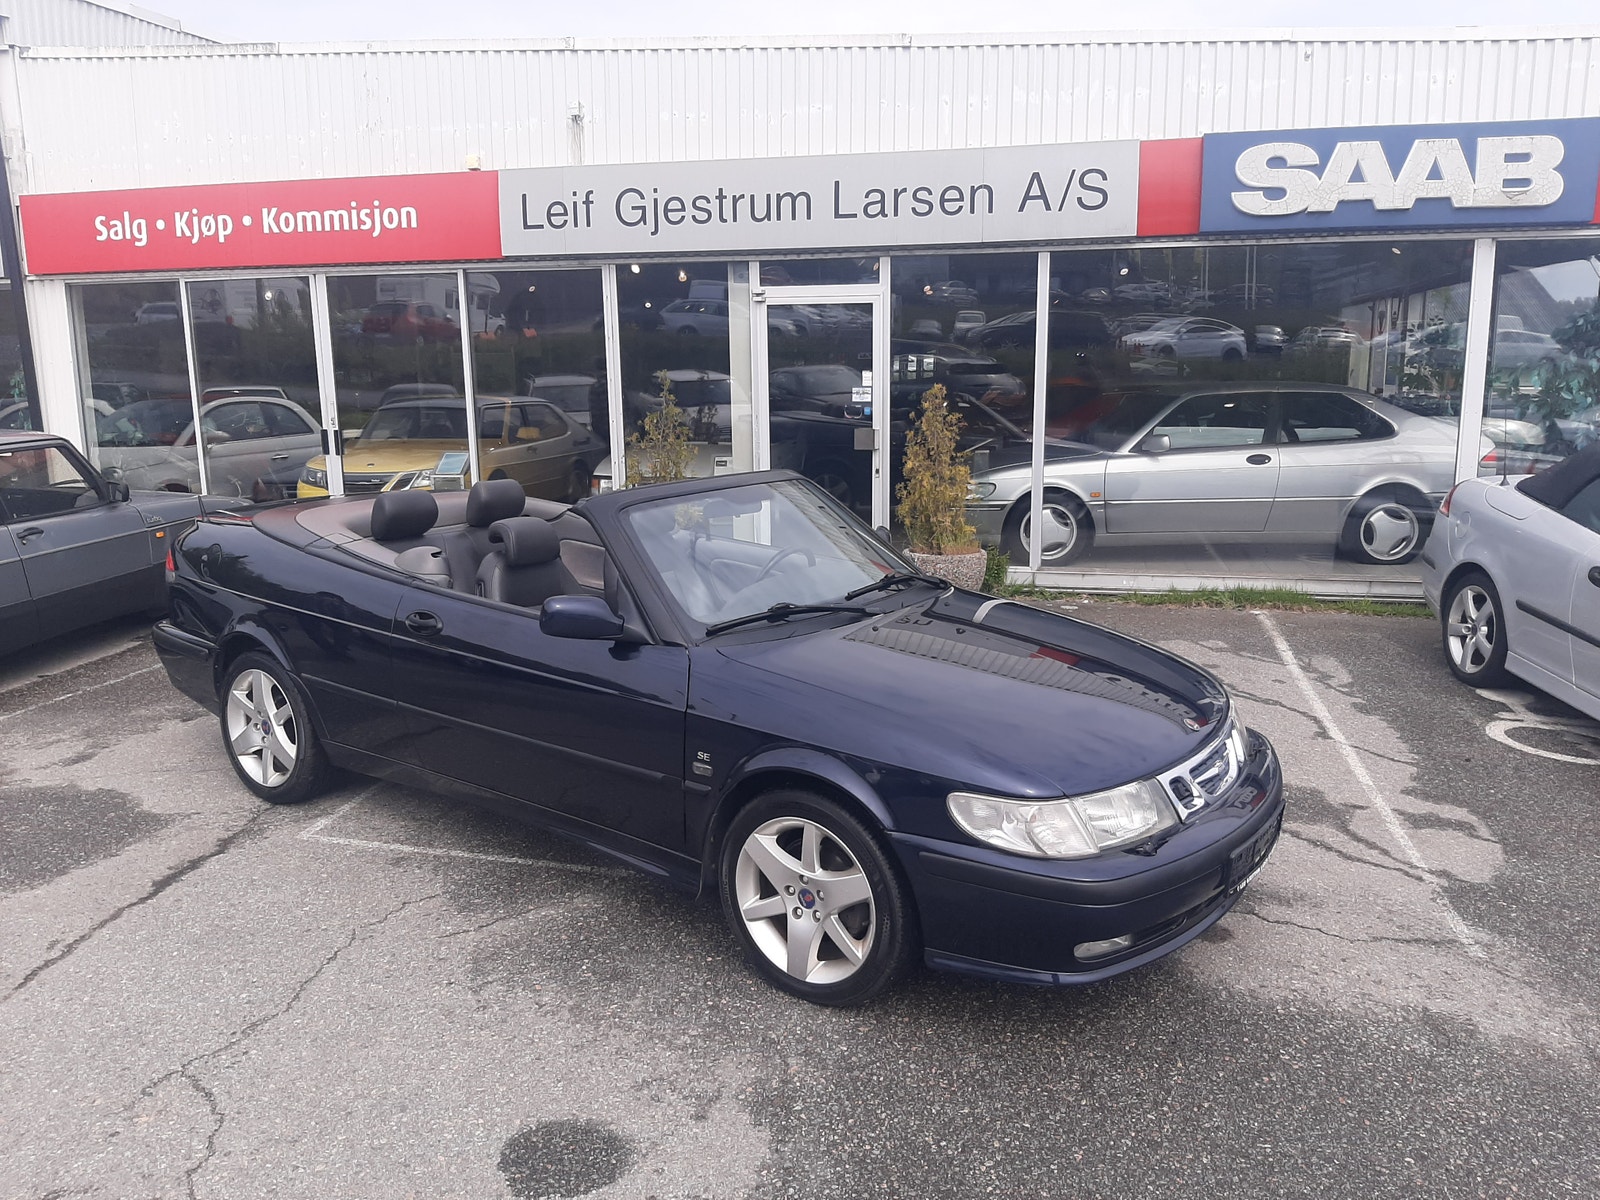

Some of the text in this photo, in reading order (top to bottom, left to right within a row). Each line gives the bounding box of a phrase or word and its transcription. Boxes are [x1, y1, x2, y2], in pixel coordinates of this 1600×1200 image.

[520, 167, 1110, 236] Leif Gjestrum Larsen A/S
[1231, 135, 1565, 216] SAAB
[94, 199, 418, 247] Salg Kjøp Kommisjon
[697, 751, 711, 762] SE
